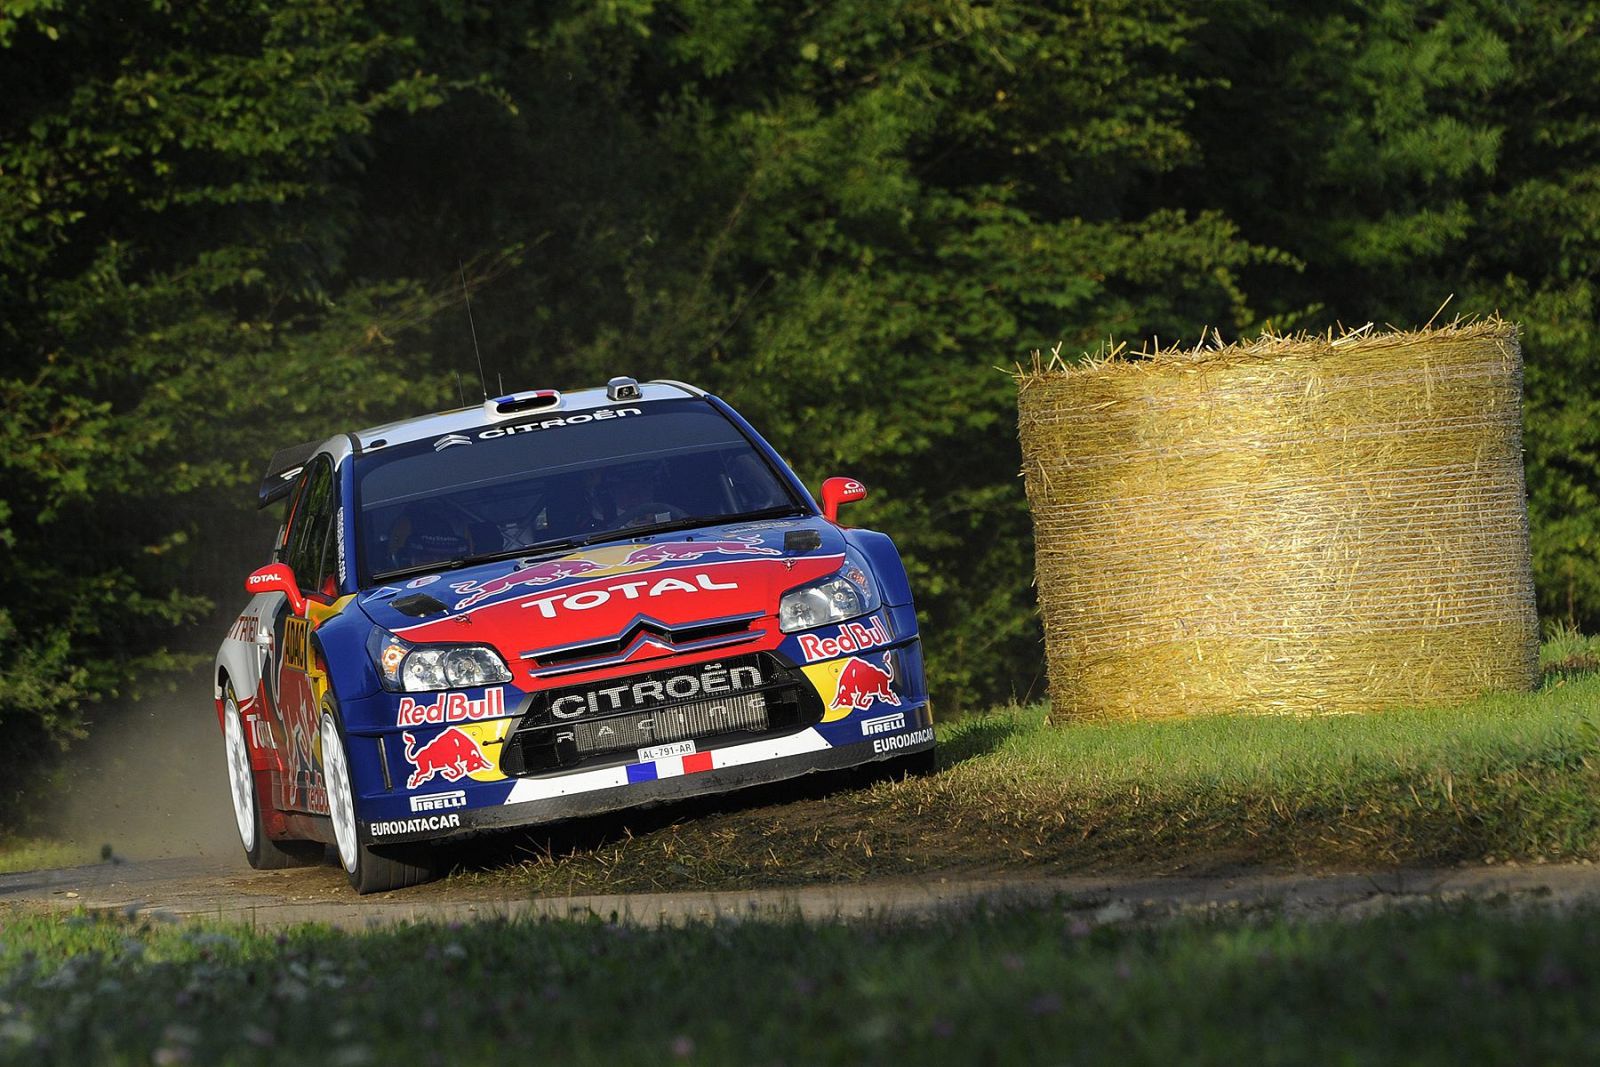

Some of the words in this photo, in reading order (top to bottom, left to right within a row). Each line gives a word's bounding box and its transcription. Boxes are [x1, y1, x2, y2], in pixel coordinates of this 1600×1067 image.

[248, 573, 282, 585] TOTAL
[521, 574, 738, 618] TOTAL
[285, 619, 306, 670] ADAC
[797, 624, 854, 663] Red
[850, 616, 892, 650] Bull
[551, 663, 762, 719] CITROËN
[397, 692, 446, 728] Red
[445, 686, 505, 722] Bull
[861, 712, 905, 736] PIRELLI
[643, 743, 692, 760] AL-791-AR
[873, 729, 934, 753] EURODATACAR
[409, 790, 467, 812] PIRELLI
[371, 814, 460, 836] EURODATACAR
